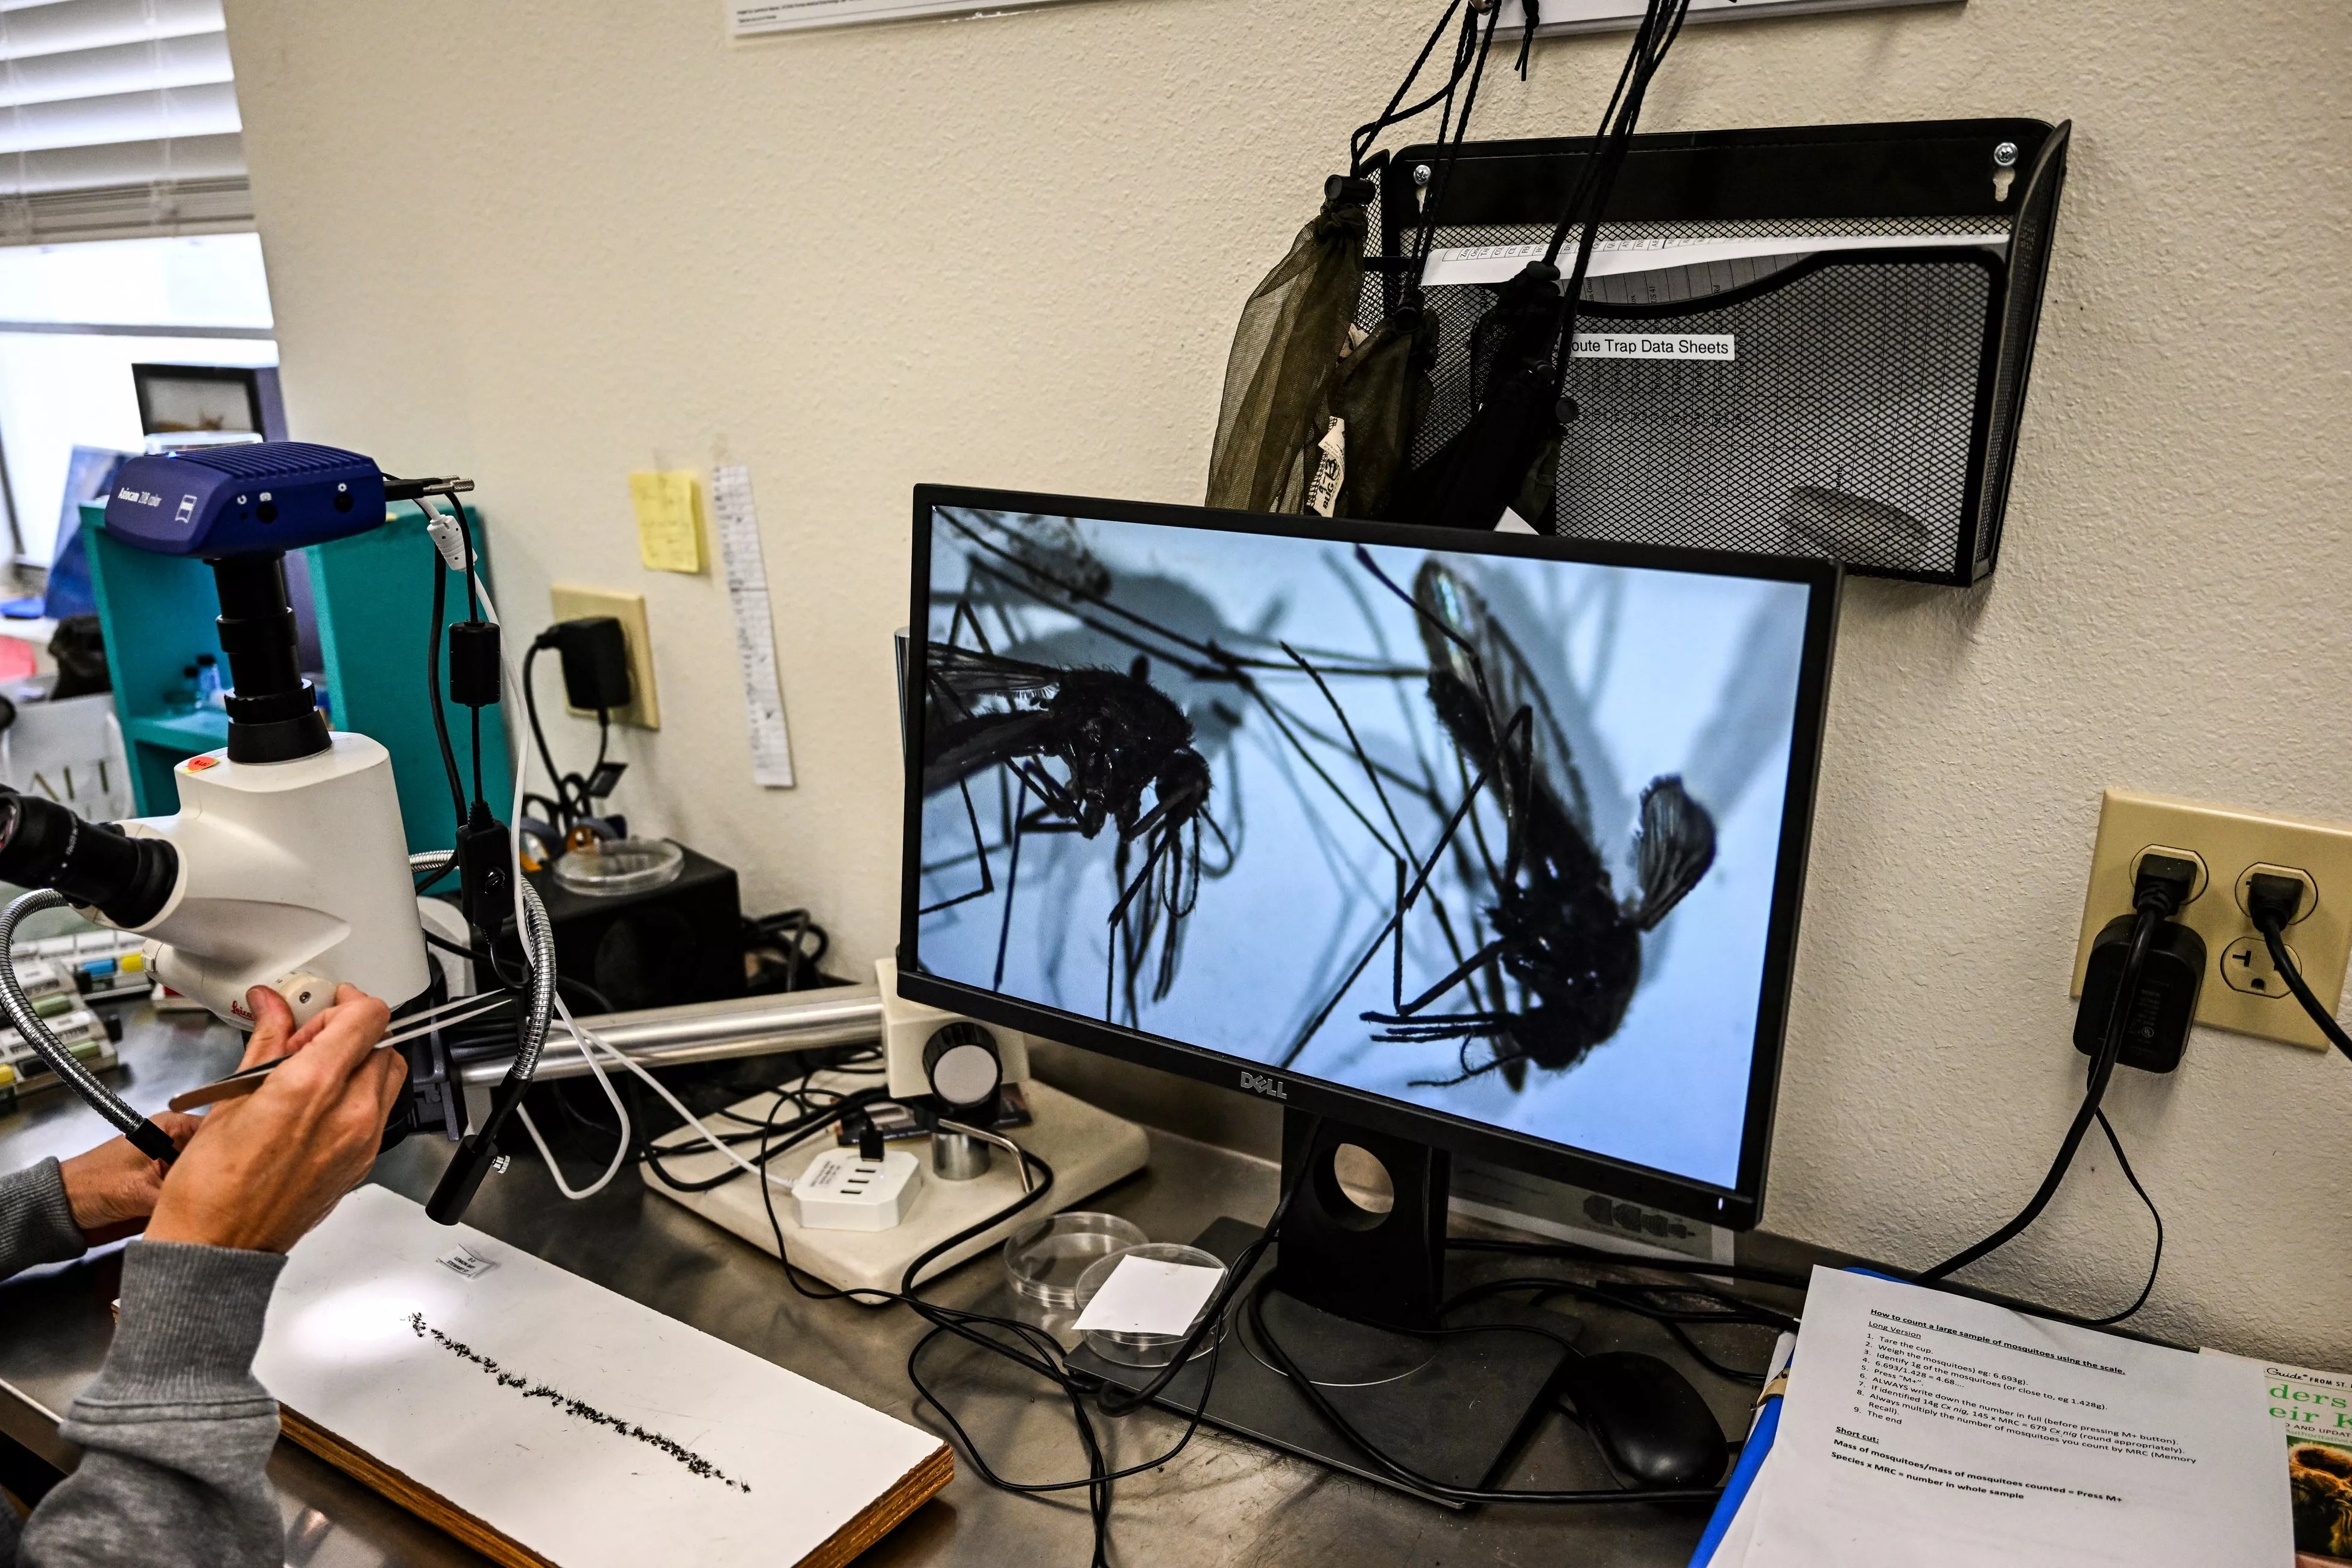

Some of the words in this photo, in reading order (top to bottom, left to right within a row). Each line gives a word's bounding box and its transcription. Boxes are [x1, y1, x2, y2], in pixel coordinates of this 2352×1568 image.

[1571, 340, 1601, 352] oute
[1604, 338, 1637, 354] Trap
[1641, 339, 1674, 353] Data
[1678, 340, 1729, 354] Sheets
[1240, 1071, 1288, 1099] DELL
[1868, 1321, 1888, 1332] Long
[1889, 1326, 1921, 1340] Version
[1870, 1309, 1890, 1320] How
[1891, 1314, 1901, 1323] to
[1902, 1318, 1928, 1329] count
[1936, 1324, 1958, 1336] large
[1959, 1331, 1991, 1344] sample
[2003, 1342, 2055, 1360] mosquitoes
[2056, 1355, 2081, 1366] using
[2082, 1361, 2098, 1370] the
[2099, 1365, 2126, 1376] scale.
[1879, 1336, 1898, 1345] Tare
[1915, 1346, 1933, 1355] cup.
[1874, 1368, 1896, 1379] Press
[1875, 1361, 1927, 1378] 6.693/1.428
[1878, 1344, 1905, 1356] Weigh
[1906, 1351, 1921, 1360] the
[1923, 1356, 1976, 1374] mosquitoes)
[1993, 1373, 2028, 1386] 6.693g).
[1877, 1352, 1909, 1366] Identify
[1911, 1361, 1921, 1370] 1g
[1950, 1372, 2001, 1388] mosquitoes
[2003, 1383, 2017, 1391] (or
[2018, 1388, 2041, 1397] close
[2071, 1399, 2108, 1411] 1.428g).
[2309, 1377, 2333, 1385] FROM
[2269, 1383, 2347, 1408] ders
[1867, 1410, 1883, 1420] The
[1885, 1417, 1902, 1425] end
[1868, 1402, 1899, 1415] Recall).
[1872, 1377, 1908, 1391] ALWAYS
[1910, 1387, 1933, 1397] write
[1935, 1393, 1959, 1404] down
[1979, 1405, 2014, 1416] number
[2027, 1414, 2041, 1423] full
[2044, 1418, 2078, 1429] (before
[2080, 1426, 2119, 1437] pressing
[2140, 1434, 2178, 1446] button).
[2269, 1406, 2320, 1423] eir
[2333, 1412, 2352, 1428] K
[1870, 1393, 1900, 1406] Always
[1902, 1403, 1938, 1417] multiply
[1939, 1412, 1955, 1420] the
[1957, 1417, 1993, 1429] number
[2006, 1428, 2060, 1443] mosquitoes
[2061, 1436, 2079, 1446] you
[2081, 1442, 2109, 1450] count
[2125, 1448, 2148, 1456] MRC
[2151, 1452, 2196, 1464] (Memory
[1879, 1386, 1921, 1403] identified
[1923, 1399, 1939, 1408] 14g
[1953, 1407, 1969, 1415] nig,
[1973, 1411, 1988, 1419] 145
[1998, 1417, 2020, 1426] MRC
[2030, 1423, 2047, 1432] 679
[2079, 1432, 2111, 1443] (round
[2114, 1439, 2185, 1454] appropriately).
[1835, 1426, 1860, 1440] Short
[1861, 1435, 1879, 1444] cut:
[2319, 1428, 2351, 1437] UPDAT
[1831, 1451, 1865, 1466] Species
[1874, 1464, 1897, 1475] MRC
[1906, 1474, 1944, 1486] number
[1957, 1484, 1987, 1494] whole
[1990, 1490, 2025, 1499] sample
[1833, 1438, 1857, 1450] Mass
[1871, 1450, 1952, 1475] mosquitoes/mass
[1967, 1474, 2023, 1487] mosquitoes
[2025, 1483, 2066, 1494] counted
[2076, 1490, 2104, 1500] Press
